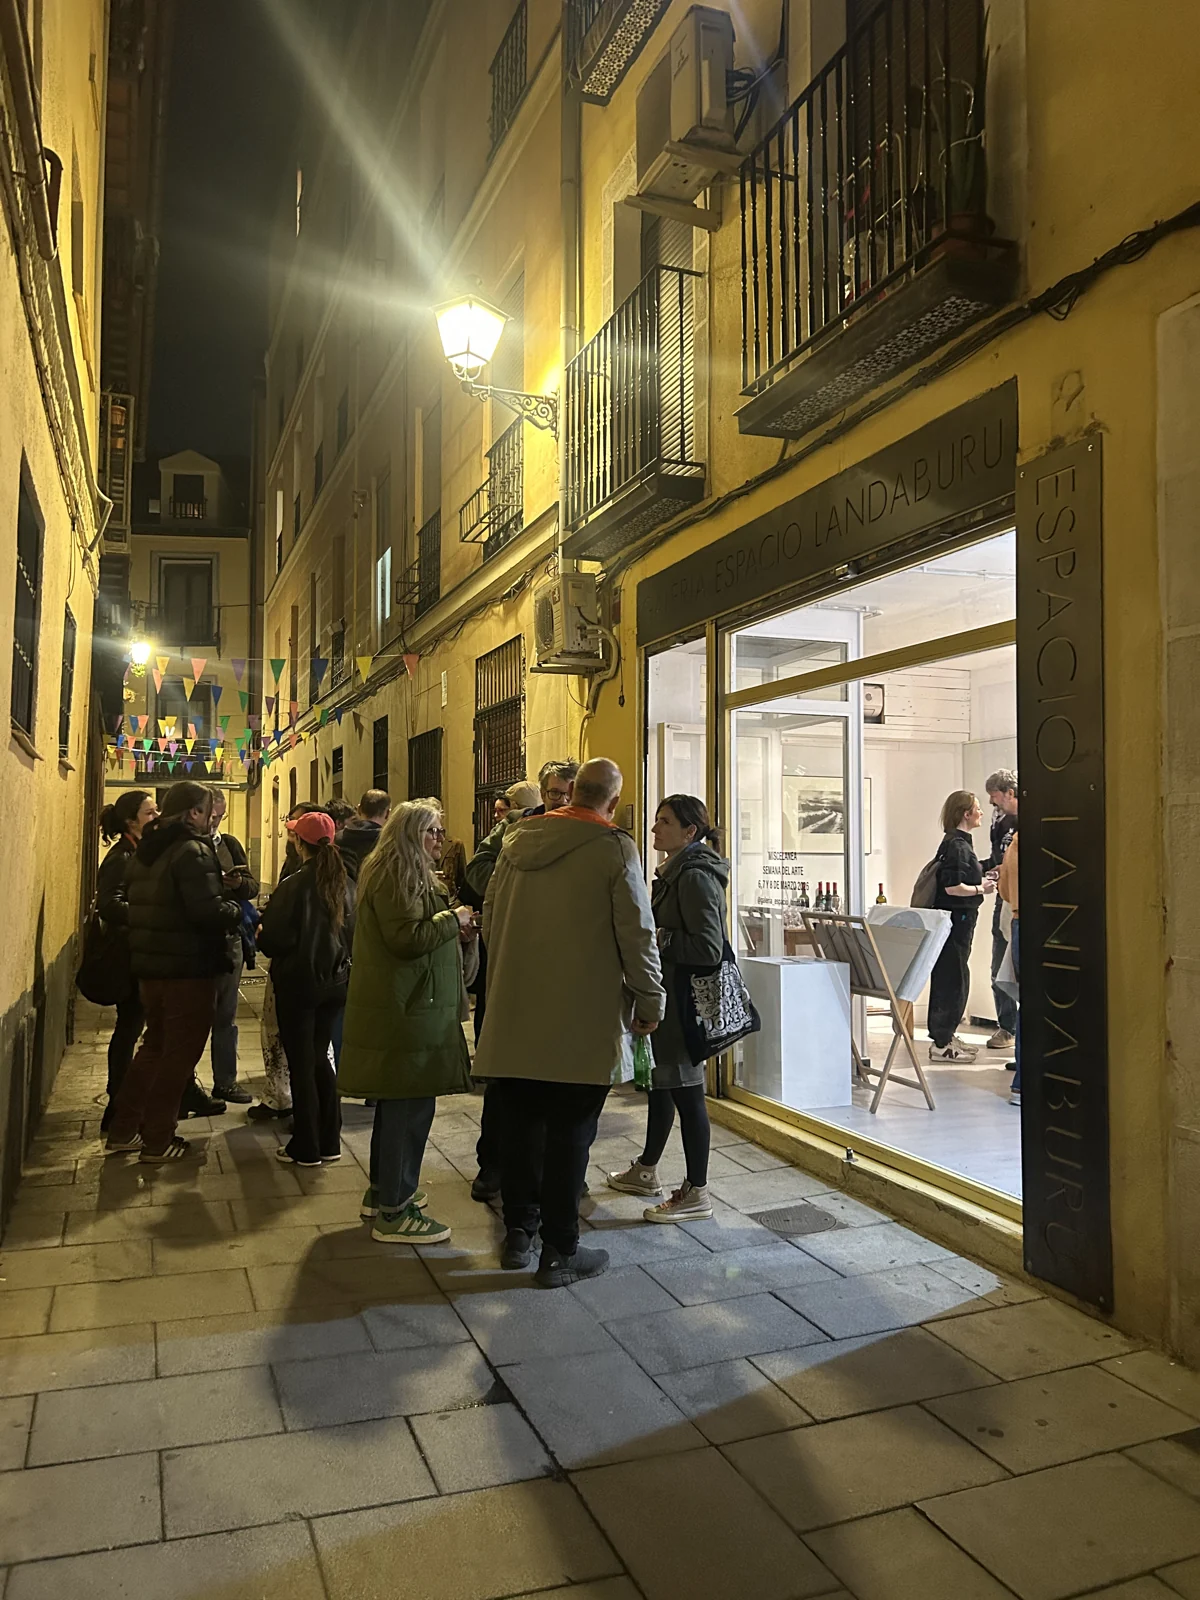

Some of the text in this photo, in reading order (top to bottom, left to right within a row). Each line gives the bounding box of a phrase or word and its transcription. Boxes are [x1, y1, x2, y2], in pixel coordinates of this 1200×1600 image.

[715, 522, 801, 594] ESPACIO
[814, 418, 1003, 548] LANDABURU
[762, 866, 804, 876] SEMANA DEL ARTE
[1036, 464, 1084, 1267] ESPACIO LANDABURU
